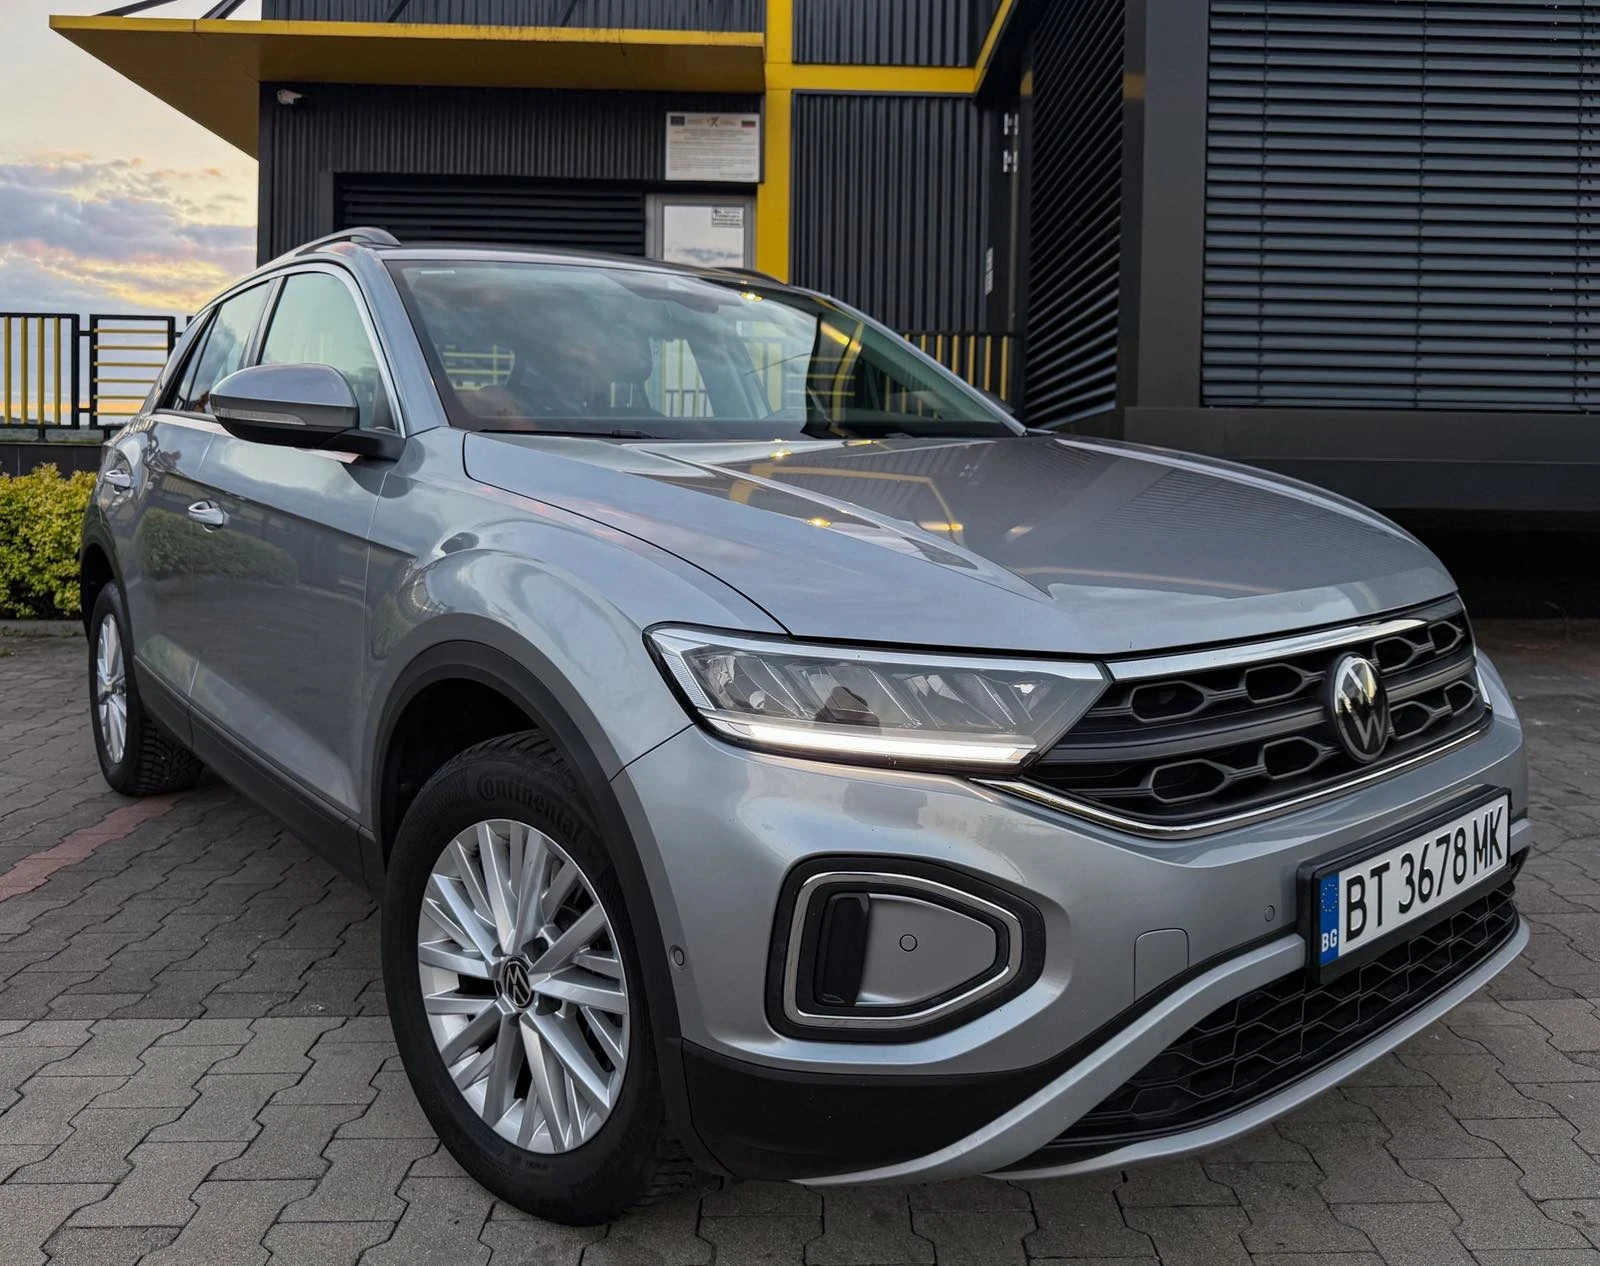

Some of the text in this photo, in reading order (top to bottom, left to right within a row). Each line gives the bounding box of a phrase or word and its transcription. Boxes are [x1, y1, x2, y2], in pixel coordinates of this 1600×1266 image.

[477, 773, 582, 844] Continental
[1346, 804, 1503, 942] BT 3678 MK
[1321, 928, 1338, 953] BG
